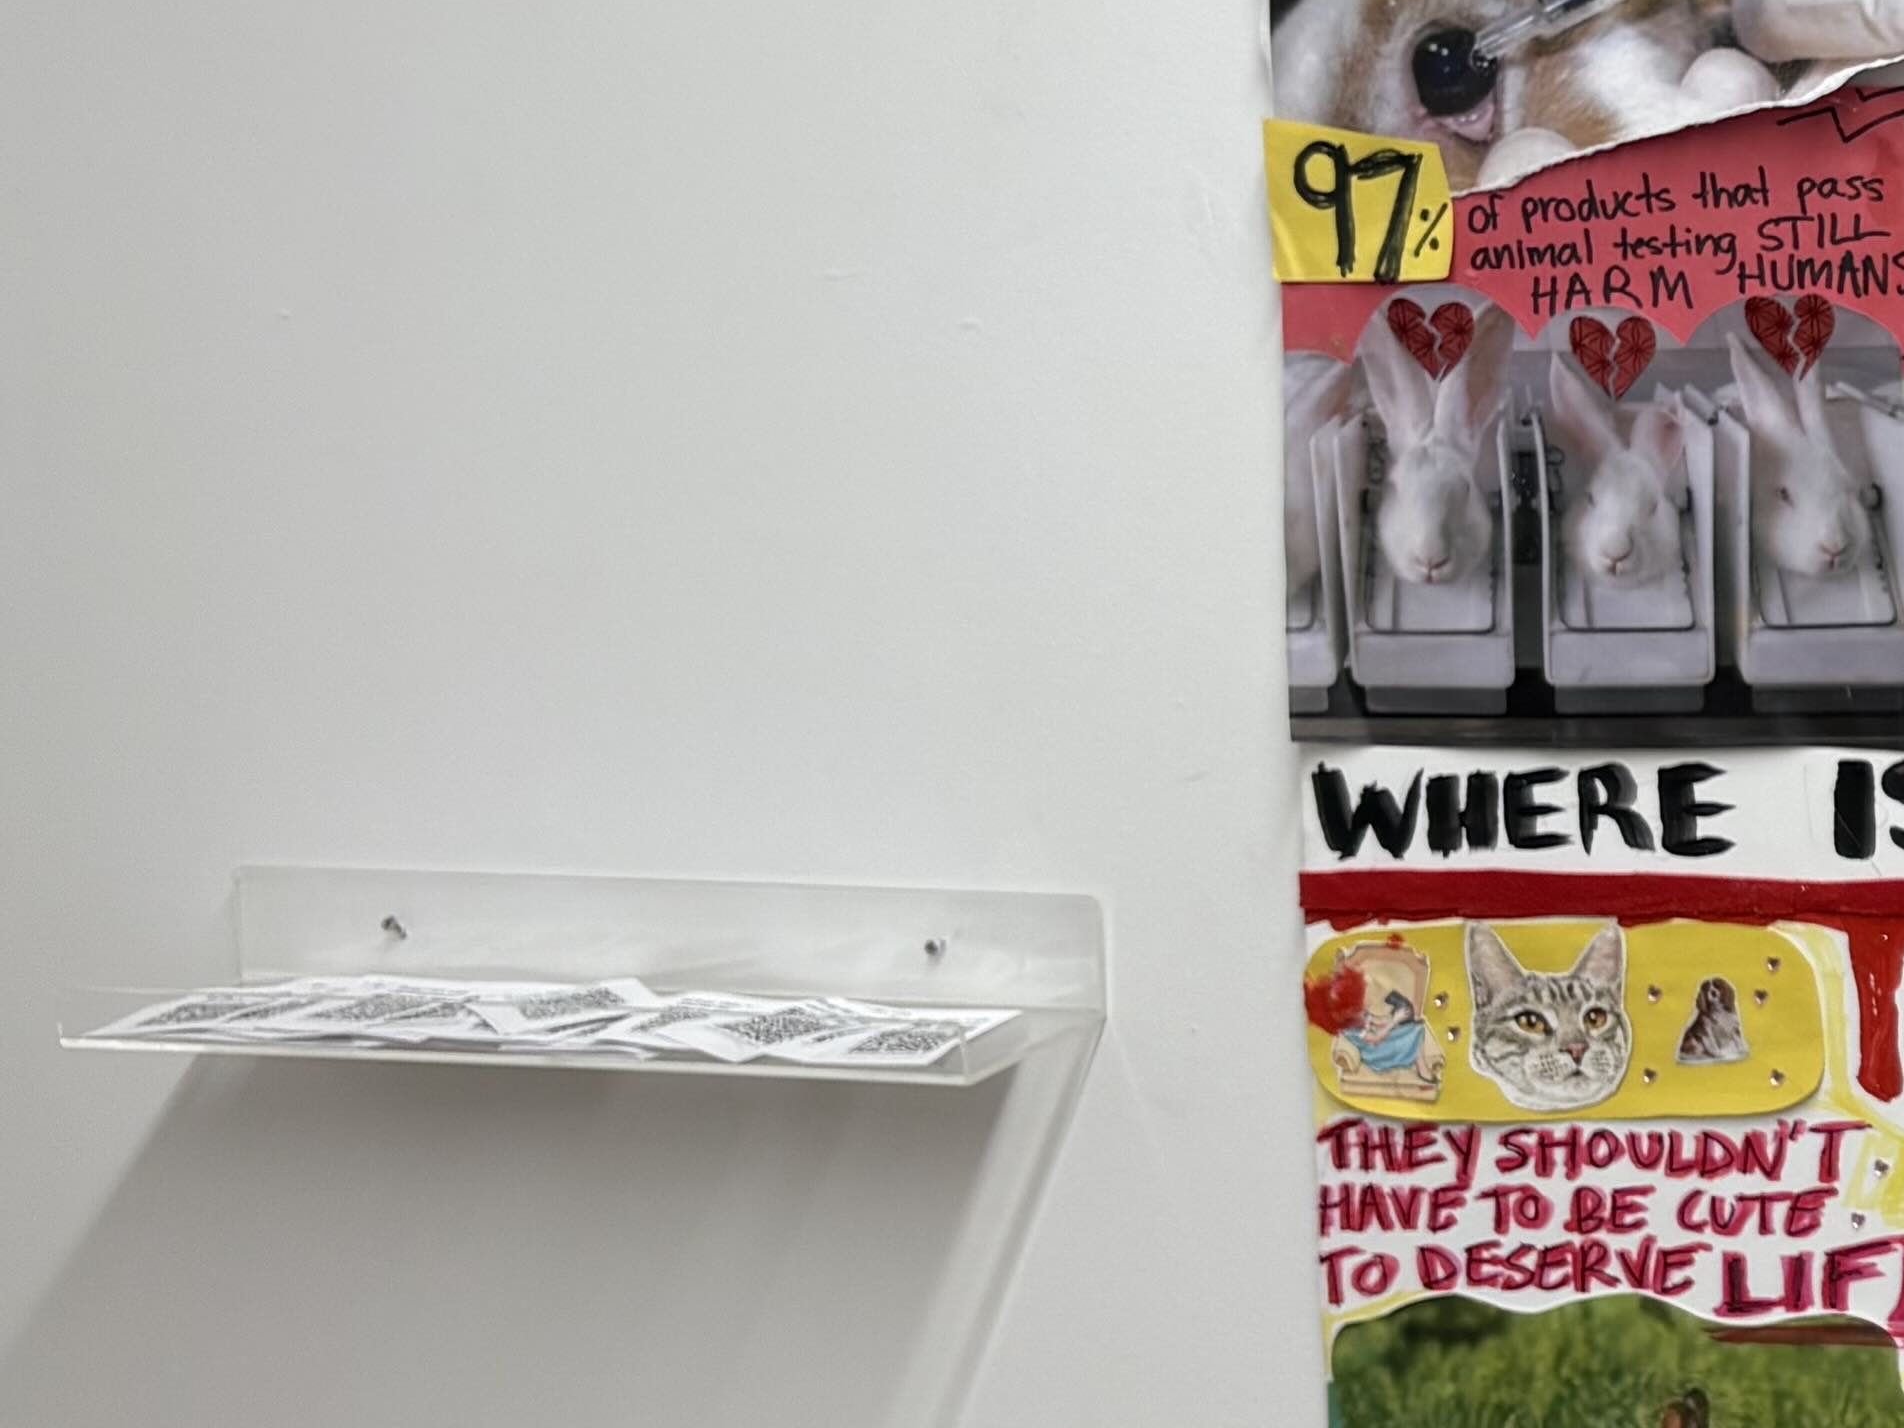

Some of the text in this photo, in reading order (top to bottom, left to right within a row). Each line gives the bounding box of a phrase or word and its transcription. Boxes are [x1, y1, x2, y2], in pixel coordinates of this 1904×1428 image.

[1295, 141, 1447, 282] 97%
[1469, 166, 1884, 233] of products that pass
[1470, 214, 1891, 273] animal testing STILL
[1531, 269, 1694, 316] HARM
[1314, 761, 1737, 860] WHERE
[1316, 1119, 1870, 1183] THEY SHOULDN'T
[1319, 1185, 1839, 1237] HAVE TO BE CUTE
[1319, 1247, 1400, 1307] TO
[1416, 1235, 1713, 1296] DESERVE
